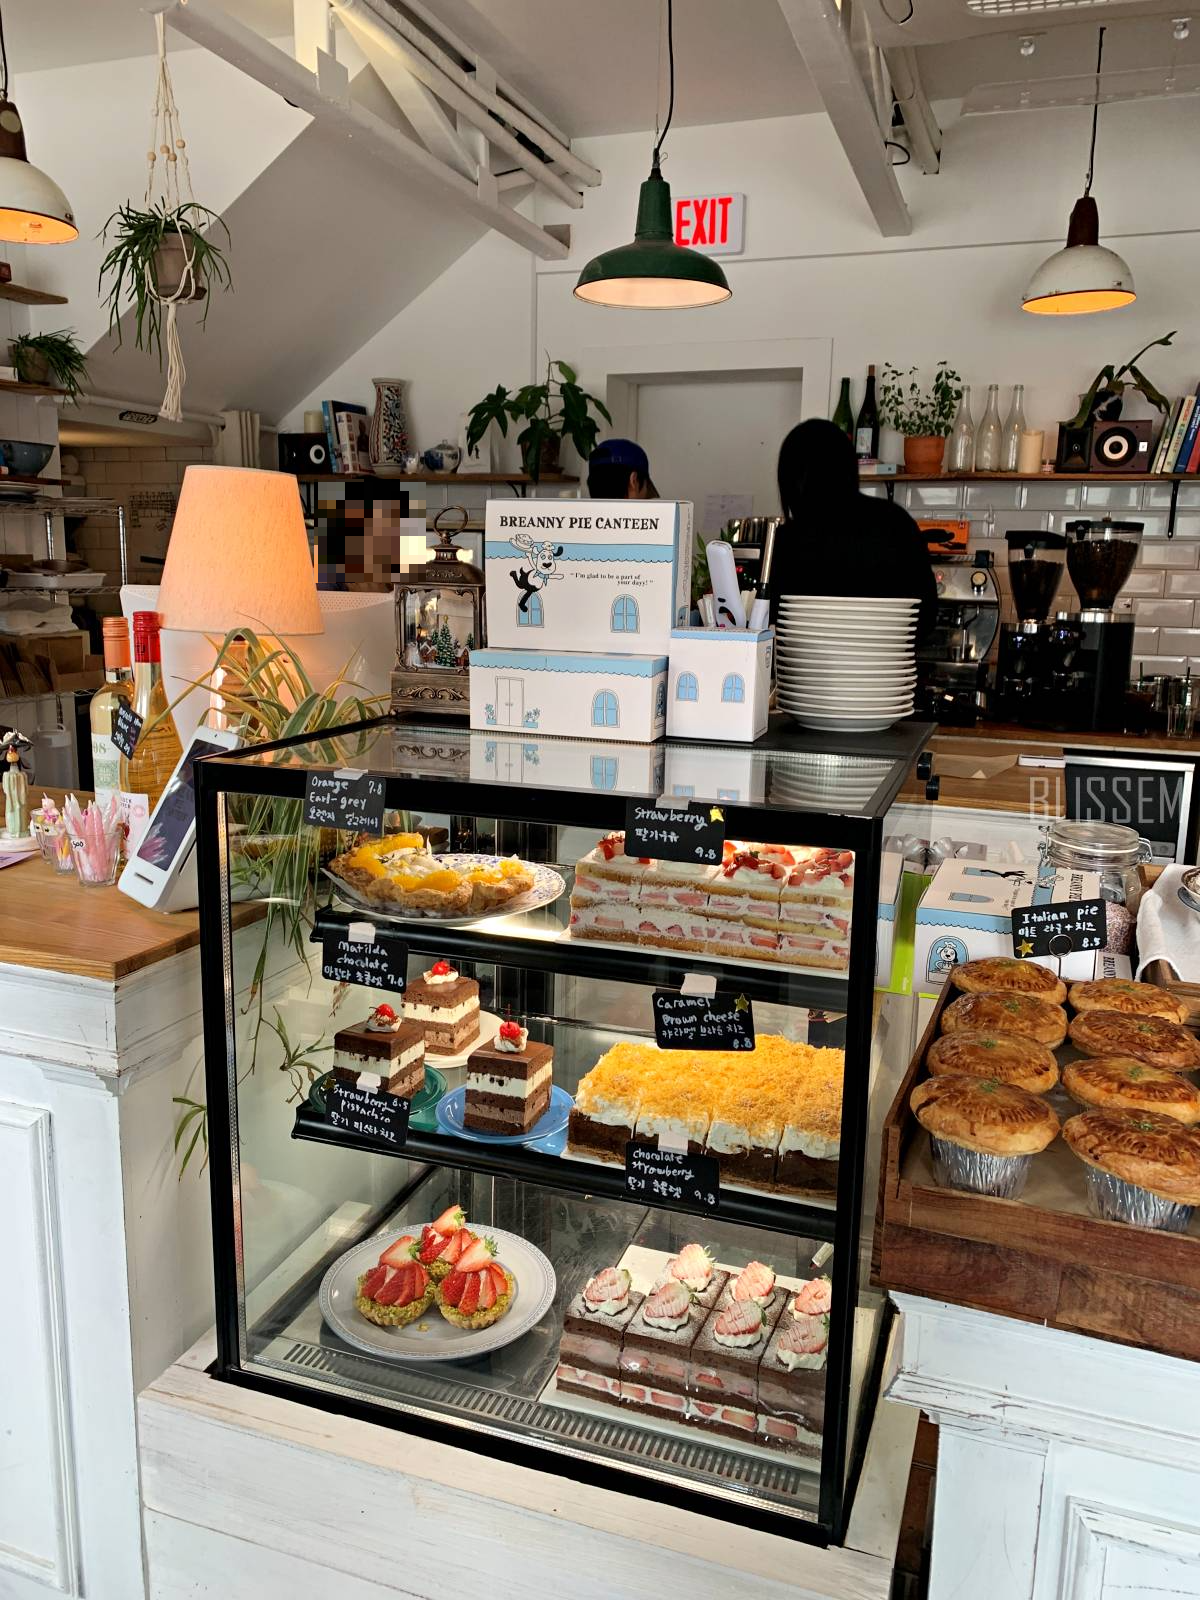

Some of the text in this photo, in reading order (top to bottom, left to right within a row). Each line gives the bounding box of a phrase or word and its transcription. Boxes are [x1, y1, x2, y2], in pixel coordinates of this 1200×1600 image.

[675, 197, 733, 246] EXIT
[499, 515, 660, 531] BREANNY PIE CANTEEN
[311, 775, 349, 794] Orange
[634, 806, 709, 832] Strawberry
[694, 846, 717, 860] 9.8
[1021, 905, 1099, 924] Italian pie
[1018, 926, 1038, 938] 미트
[338, 940, 388, 957] Matilda
[1081, 937, 1101, 948] 8.5
[336, 953, 389, 973] chocolate
[656, 996, 711, 1010] Caramel
[703, 1009, 741, 1023] cheese
[726, 1023, 746, 1034] 치즈
[330, 1111, 349, 1126] 딸기
[632, 1147, 684, 1165] chocolate
[694, 1189, 716, 1205] 9.8
